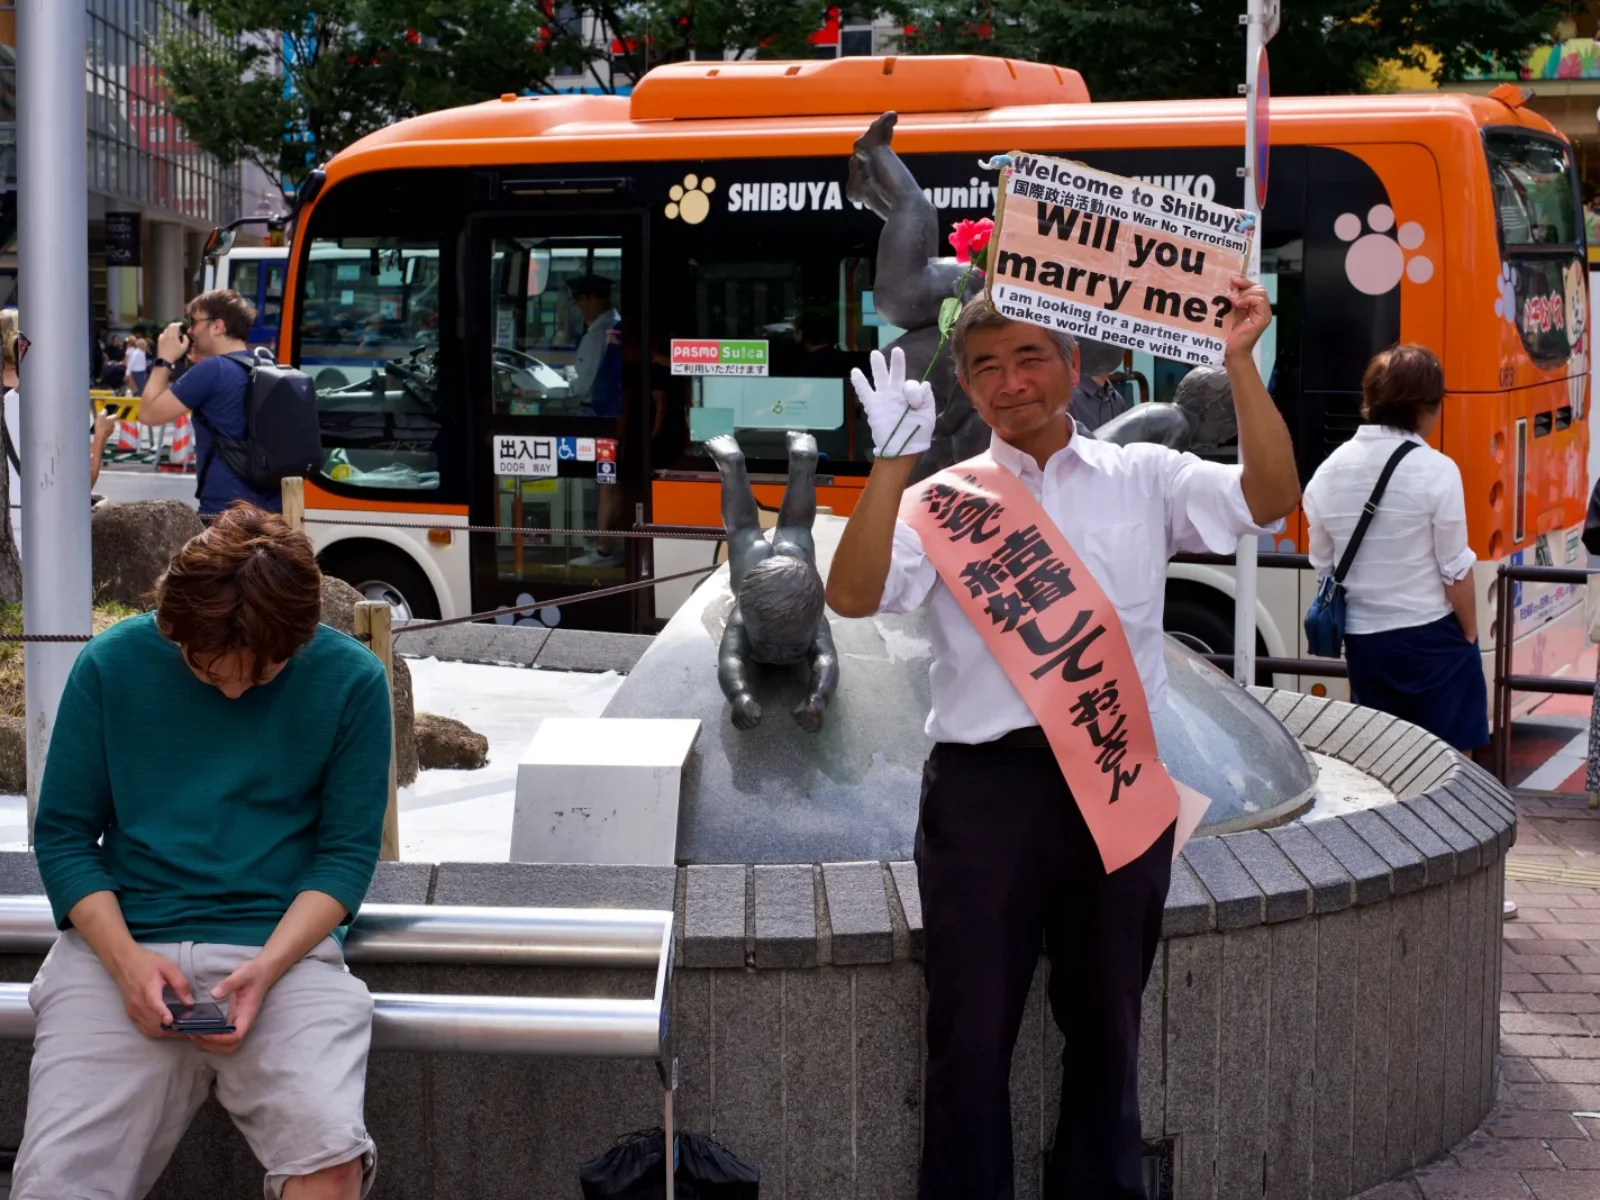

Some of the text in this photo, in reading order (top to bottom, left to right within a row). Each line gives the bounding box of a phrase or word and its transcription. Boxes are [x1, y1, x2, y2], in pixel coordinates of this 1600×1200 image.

[728, 182, 843, 212] SHIBUYA
[1014, 155, 1123, 200] Welcome
[1132, 188, 1154, 207] to
[1036, 201, 1206, 276] Will you
[1132, 211, 1158, 229] War
[1161, 220, 1178, 234] No
[1182, 226, 1248, 254] Terrorism)
[996, 250, 1233, 328] marry me?
[999, 287, 1223, 352] I am looking for a partner who
[1001, 304, 1214, 366] makes world peace with me.
[673, 346, 764, 359] PASMO Suica
[674, 363, 765, 375] ご利用いただけます
[500, 439, 551, 460] 出入口
[500, 462, 551, 473] DOOR WAY
